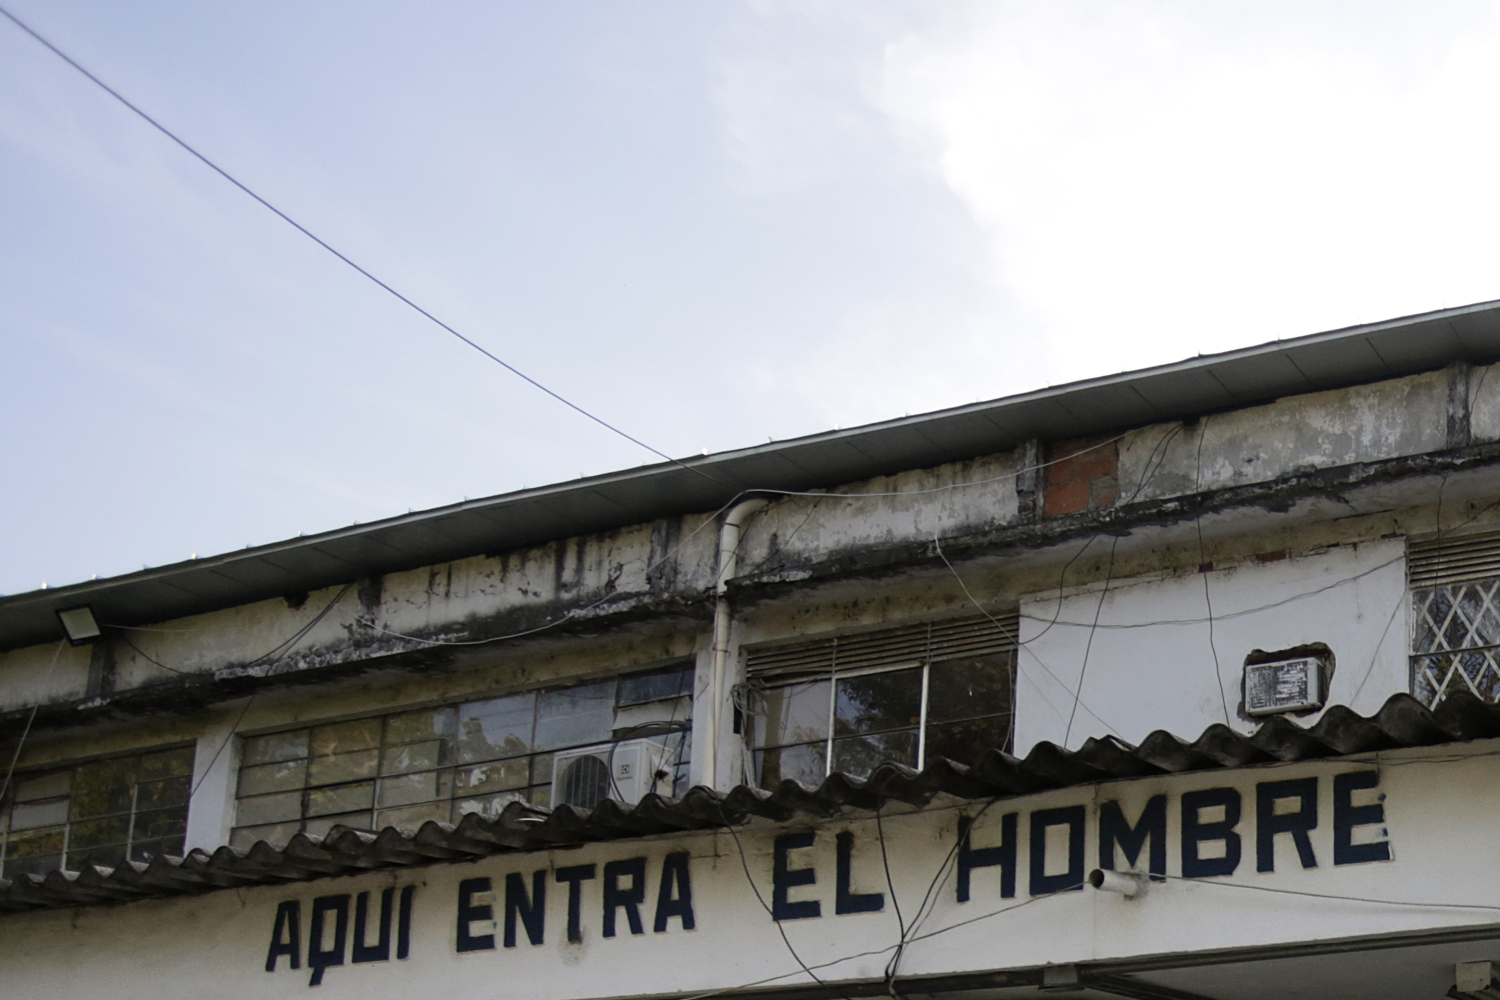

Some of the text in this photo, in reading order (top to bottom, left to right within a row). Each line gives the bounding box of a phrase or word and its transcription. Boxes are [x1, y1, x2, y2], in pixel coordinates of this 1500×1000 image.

[265, 884, 417, 986] AQUI
[455, 851, 698, 955] ENTRA
[772, 830, 886, 922] EL
[956, 770, 1394, 903] HOMBRE
